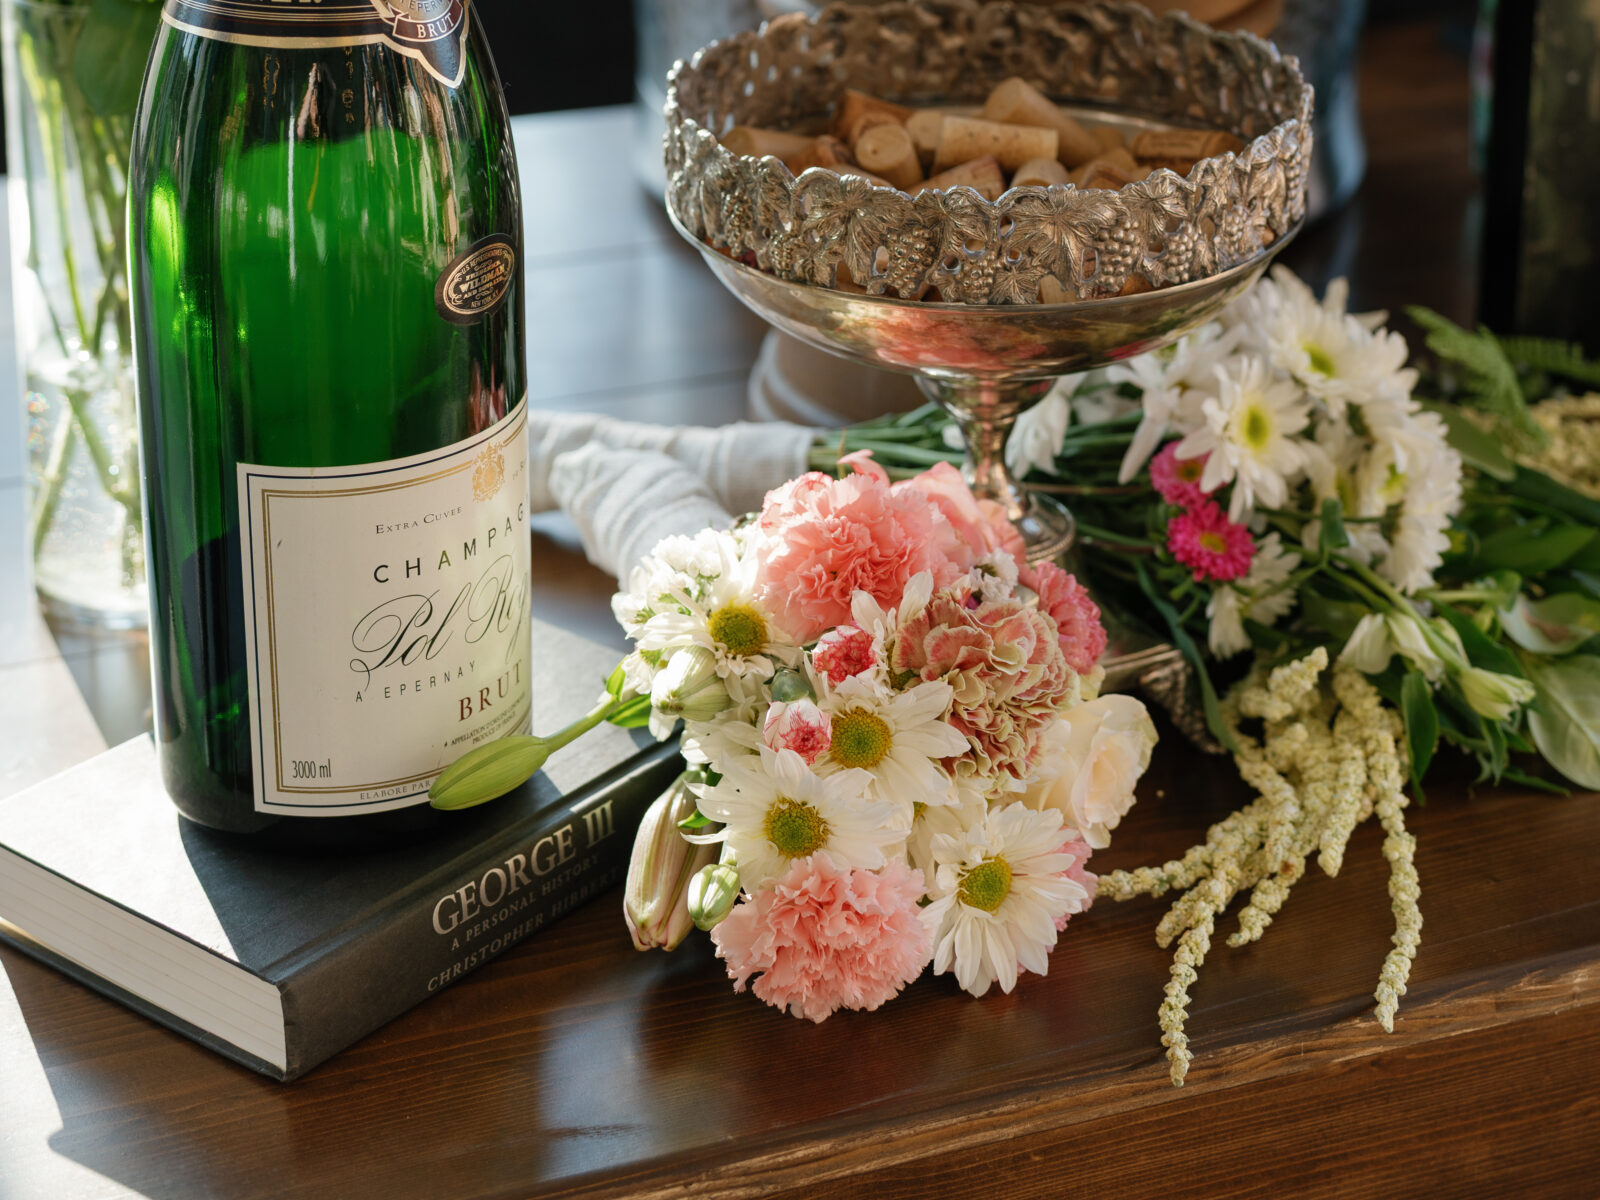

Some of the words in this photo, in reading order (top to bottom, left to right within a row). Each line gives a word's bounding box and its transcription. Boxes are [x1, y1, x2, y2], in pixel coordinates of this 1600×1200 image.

[416, 12, 455, 39] BRUT
[373, 497, 526, 584] CHAMPAG
[375, 519, 419, 535] EXTRA
[423, 506, 463, 524] CUVEE
[349, 582, 472, 692] Pol
[355, 690, 363, 703] A
[384, 660, 475, 699] EPERNAY
[458, 659, 522, 722] BRUT
[291, 760, 317, 779] 3000
[319, 758, 332, 778] ml
[360, 785, 408, 801] ELABORE
[412, 780, 431, 793] PAR
[432, 823, 577, 936] GEORGE
[581, 799, 617, 850] III
[450, 936, 461, 951] A
[466, 891, 537, 942] PERSONAL
[541, 853, 600, 895] HISTORY
[427, 912, 544, 992] CHRISTOPHER
